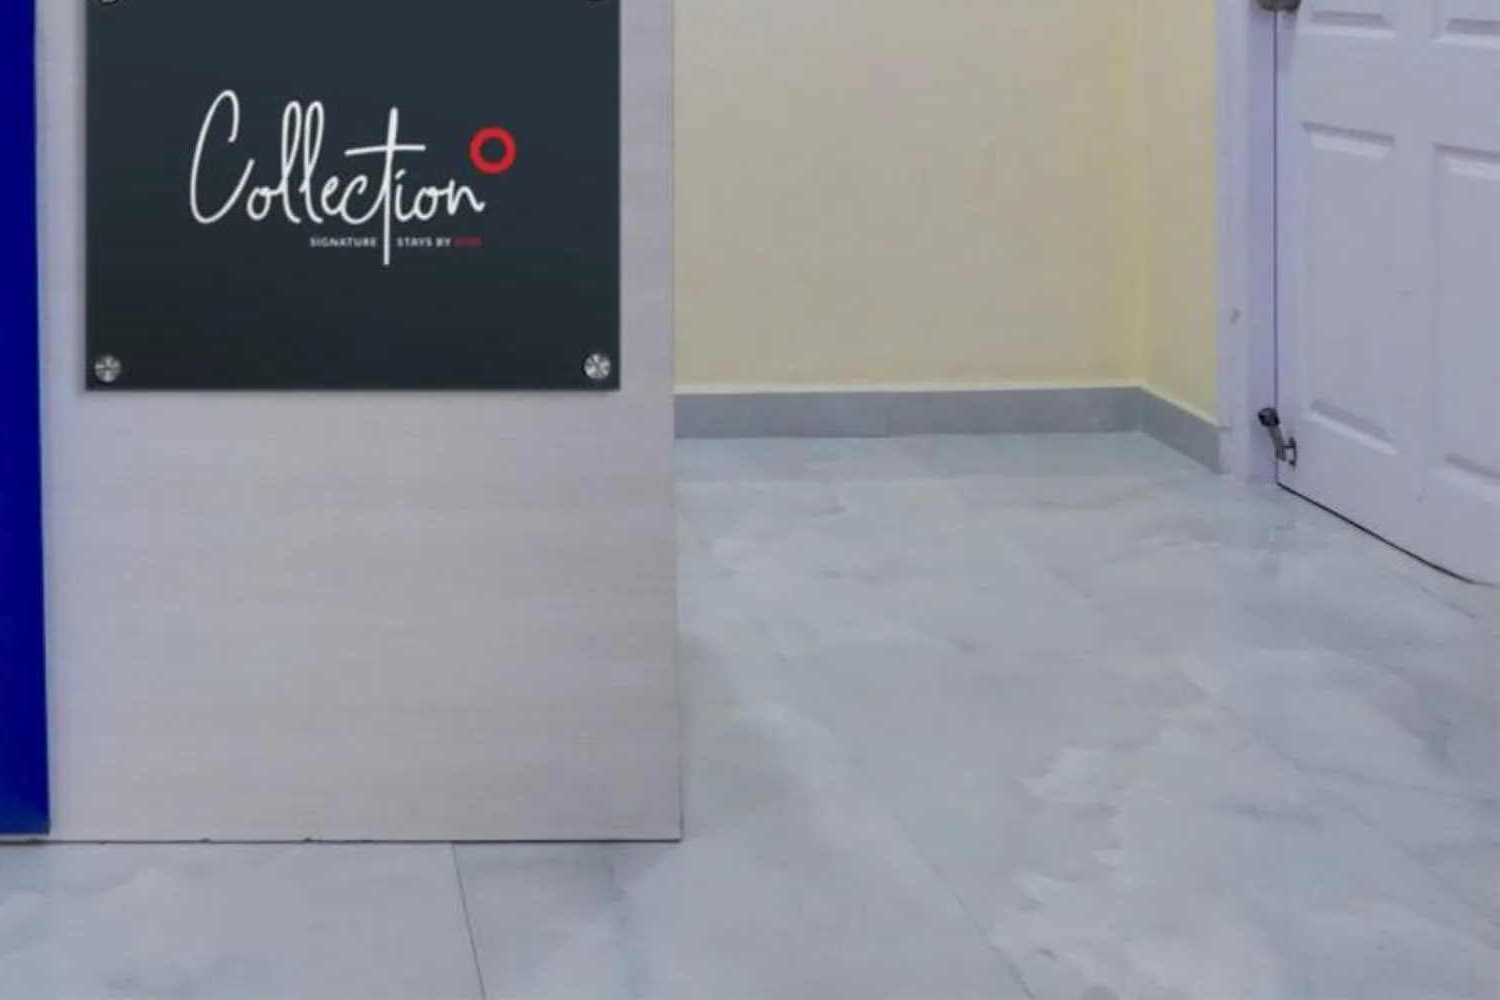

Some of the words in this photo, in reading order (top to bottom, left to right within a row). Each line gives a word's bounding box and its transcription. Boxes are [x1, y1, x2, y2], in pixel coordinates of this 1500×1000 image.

[190, 89, 486, 265] Collection
[309, 236, 377, 248] SIGNATURE
[396, 236, 433, 247] STAYS
[435, 236, 452, 247] BY
